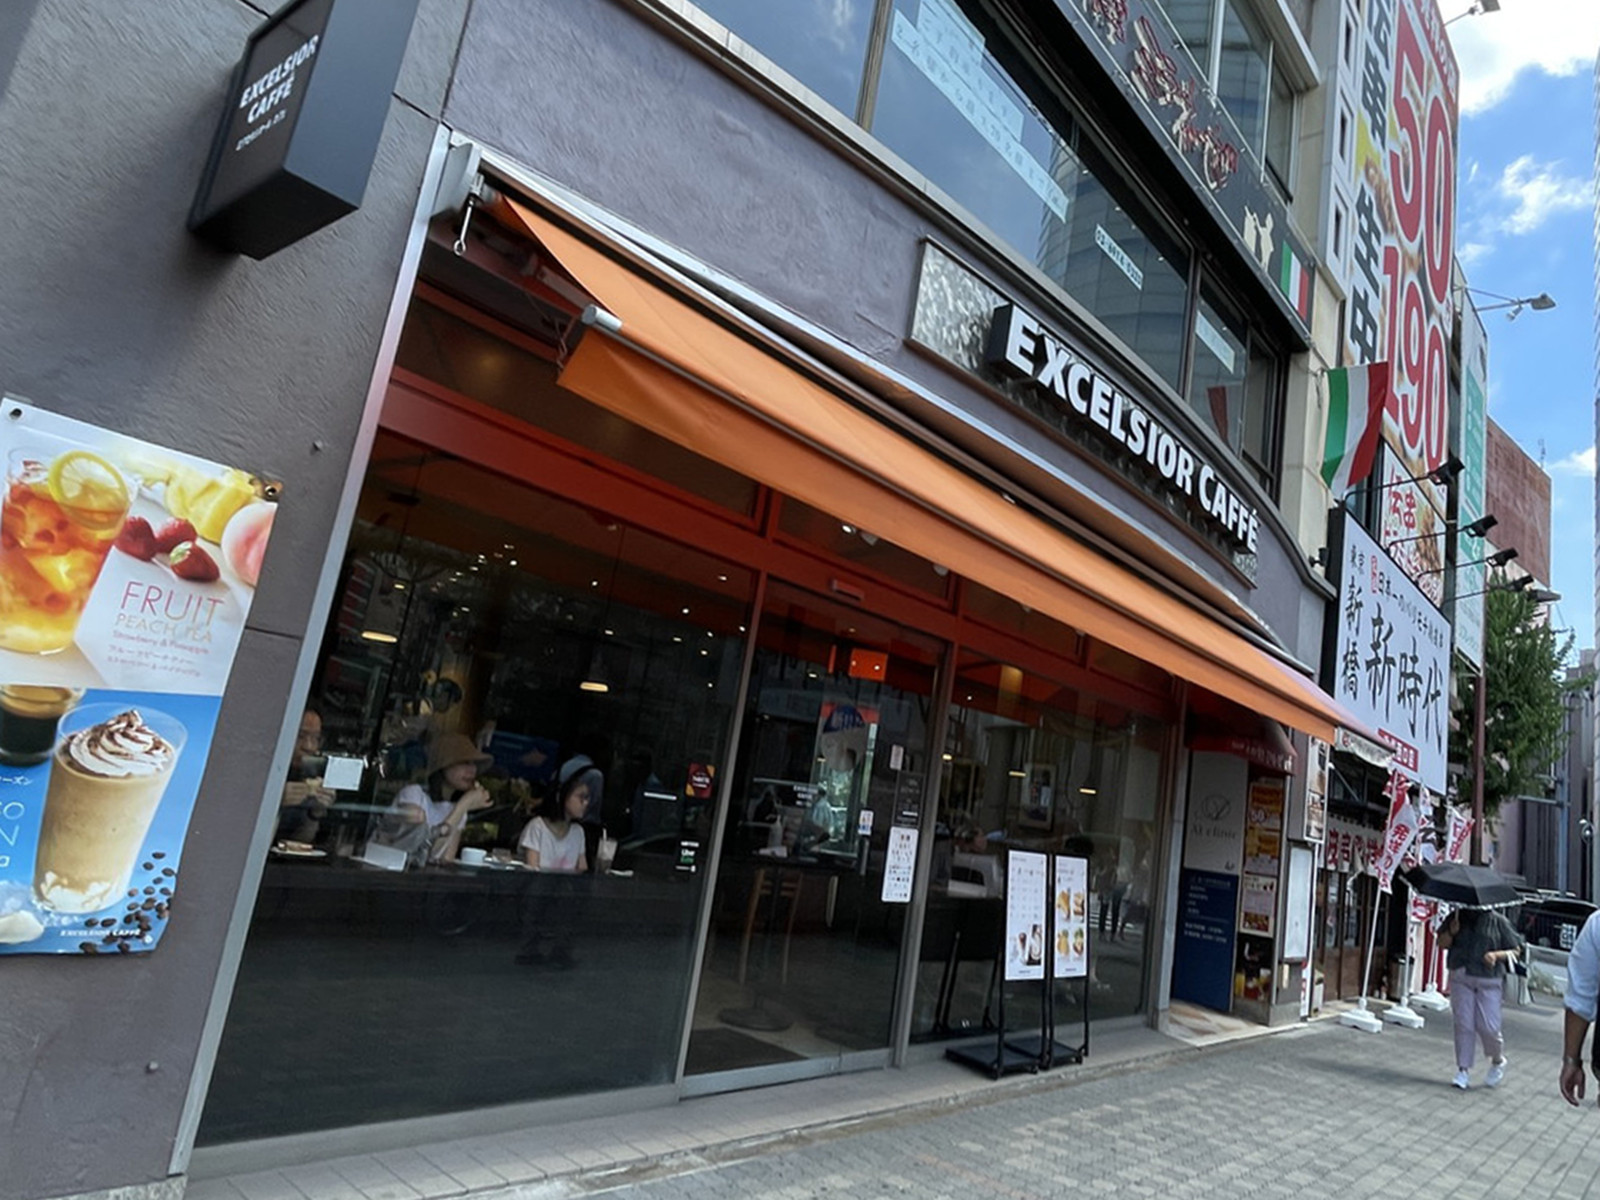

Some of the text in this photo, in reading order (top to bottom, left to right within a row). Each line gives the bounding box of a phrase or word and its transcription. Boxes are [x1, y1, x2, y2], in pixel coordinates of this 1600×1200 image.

[240, 34, 319, 108] EXCELSIOR
[1389, 0, 1453, 303] 50
[1005, 304, 1259, 553] EXCELSIOR CAFFÉ
[1382, 244, 1447, 474] 190
[114, 612, 177, 638] PEACH
[121, 581, 225, 626] FRUIT
[1341, 575, 1364, 701] 新橋
[1364, 602, 1444, 756] 新時代
